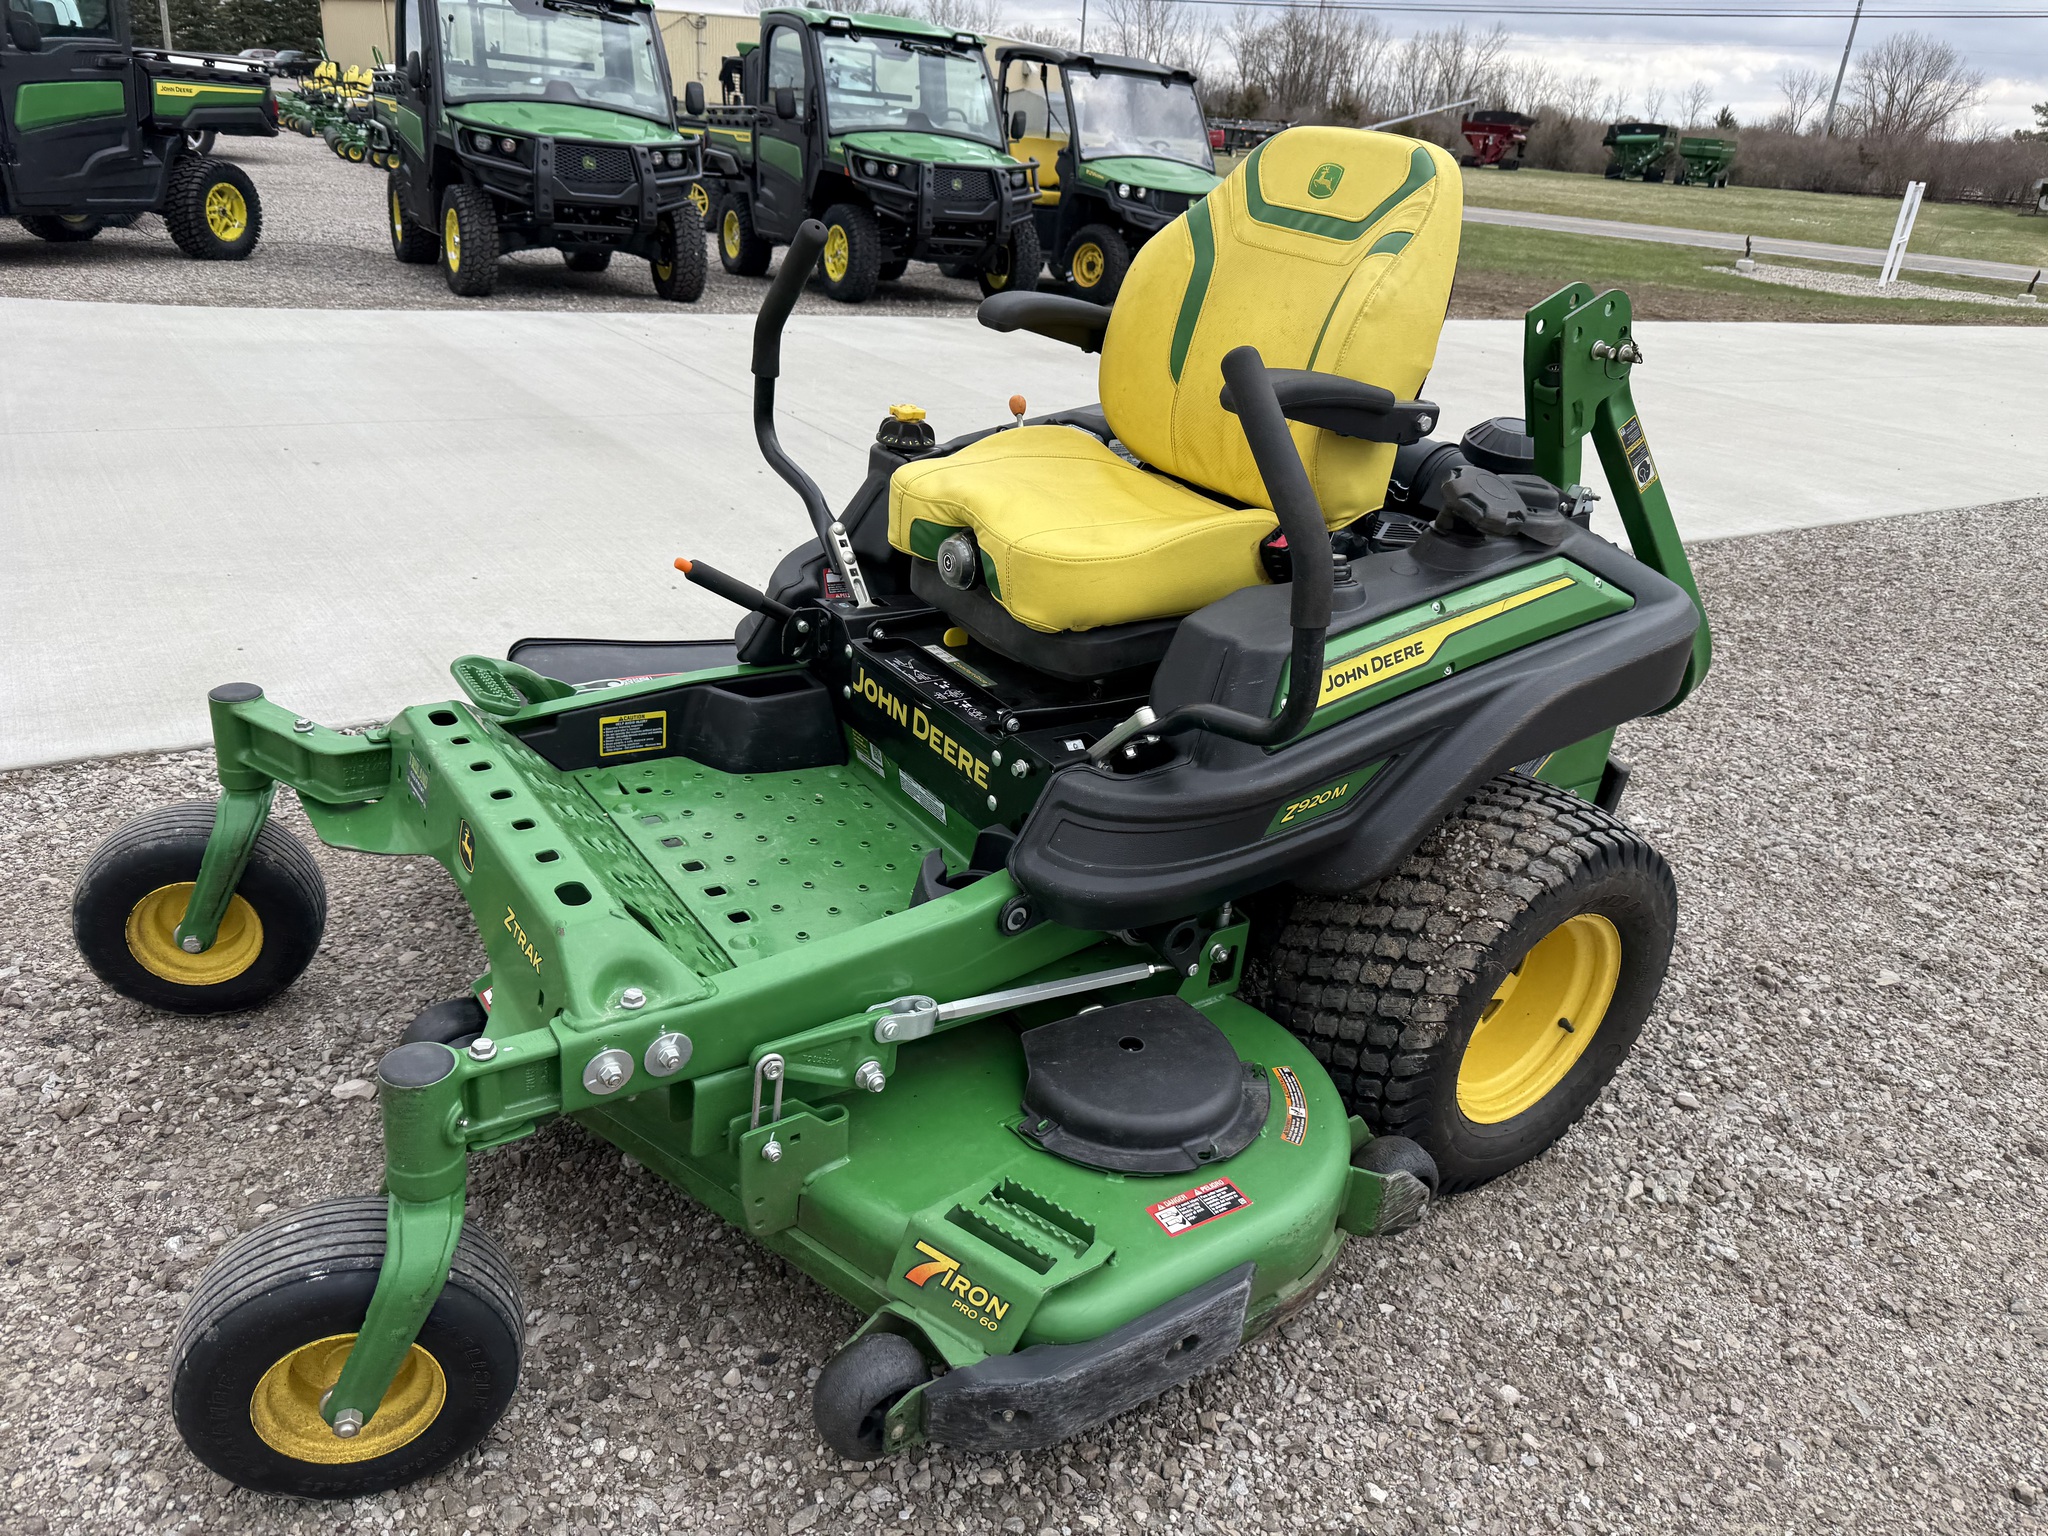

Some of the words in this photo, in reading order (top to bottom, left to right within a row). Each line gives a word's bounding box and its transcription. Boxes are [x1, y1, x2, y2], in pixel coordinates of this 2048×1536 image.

[175, 86, 193, 94] DEERE
[1325, 664, 1369, 692] JOHN
[1370, 641, 1425, 673] DEERE
[852, 666, 908, 728] JOHN
[912, 706, 990, 790] DEERE
[1280, 782, 1349, 824] Z920M
[503, 904, 543, 975] ZTRAK
[1163, 1193, 1188, 1207] DANGER
[1200, 1179, 1225, 1192] PELIGRO
[951, 1299, 979, 1320] PRO
[979, 1316, 999, 1332] 60
